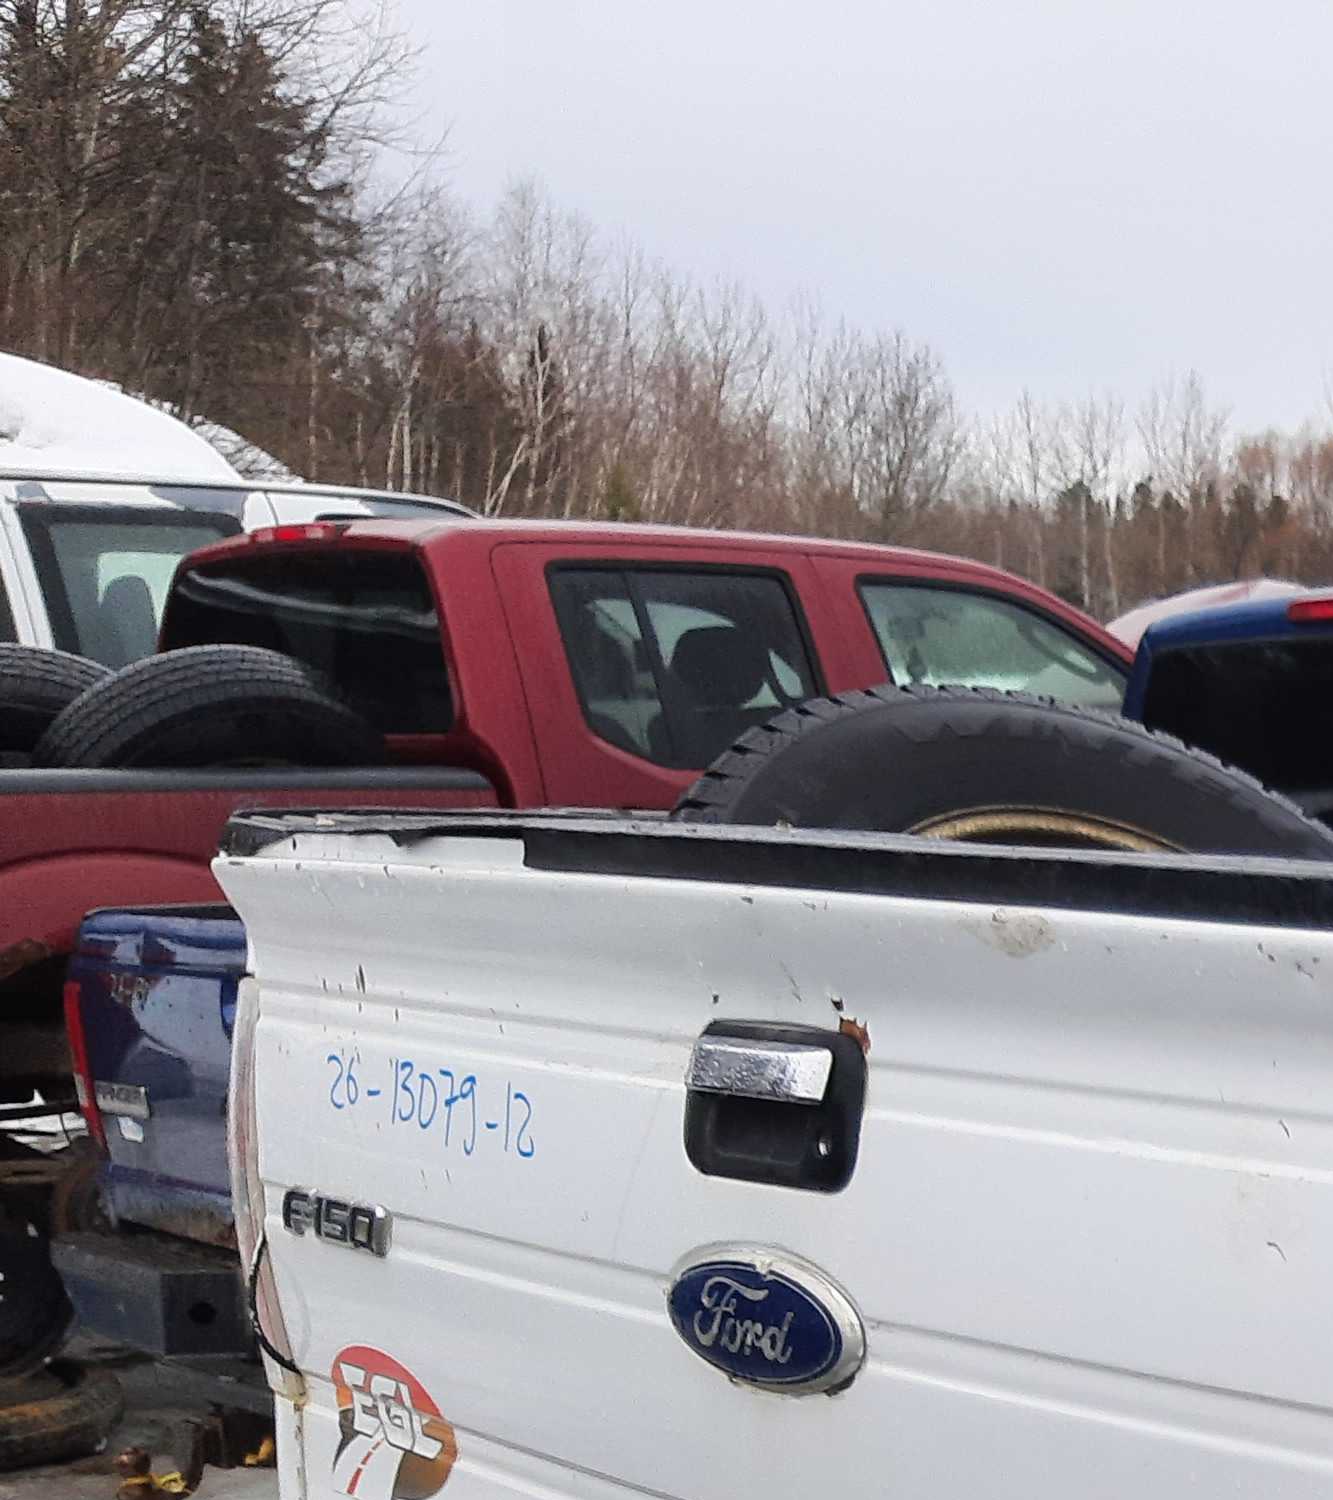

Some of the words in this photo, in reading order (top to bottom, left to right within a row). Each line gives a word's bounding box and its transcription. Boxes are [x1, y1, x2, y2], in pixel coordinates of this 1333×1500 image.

[326, 1055, 536, 1158] 26-13079-12
[693, 1276, 795, 1363] Ford
[339, 1361, 444, 1461] EGL
